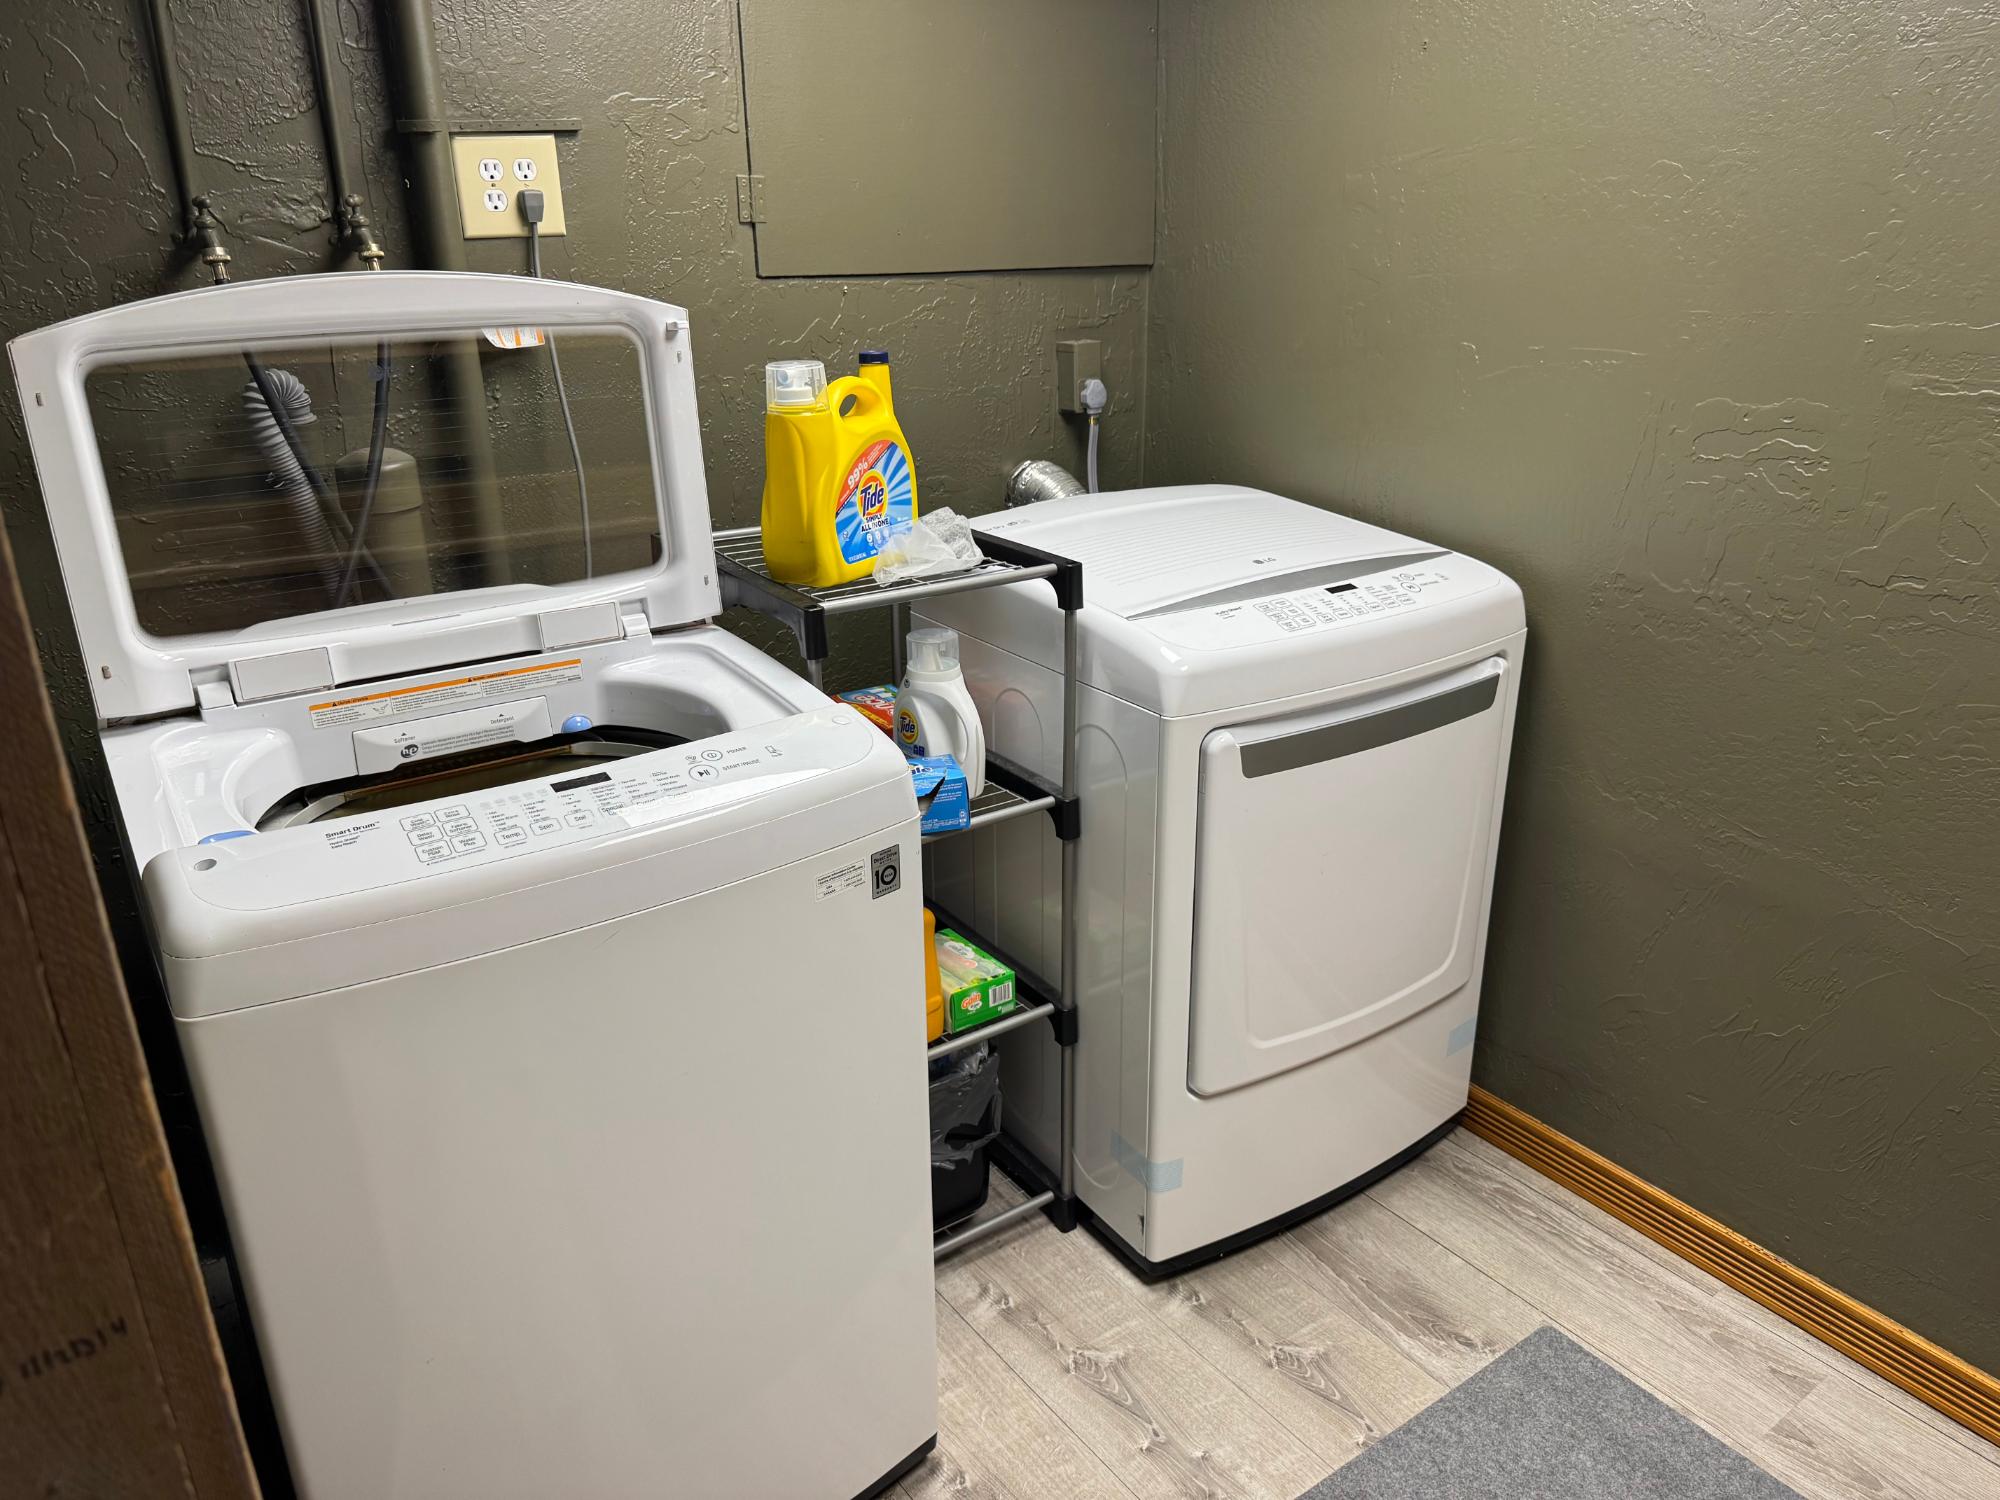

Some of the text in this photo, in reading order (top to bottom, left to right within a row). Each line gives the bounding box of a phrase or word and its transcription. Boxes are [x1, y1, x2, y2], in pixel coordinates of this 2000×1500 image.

[847, 459, 868, 489] 99%
[860, 482, 884, 516] Tide
[899, 715, 915, 733] Tide
[325, 828, 352, 839] Smart
[874, 865, 897, 890] 10
